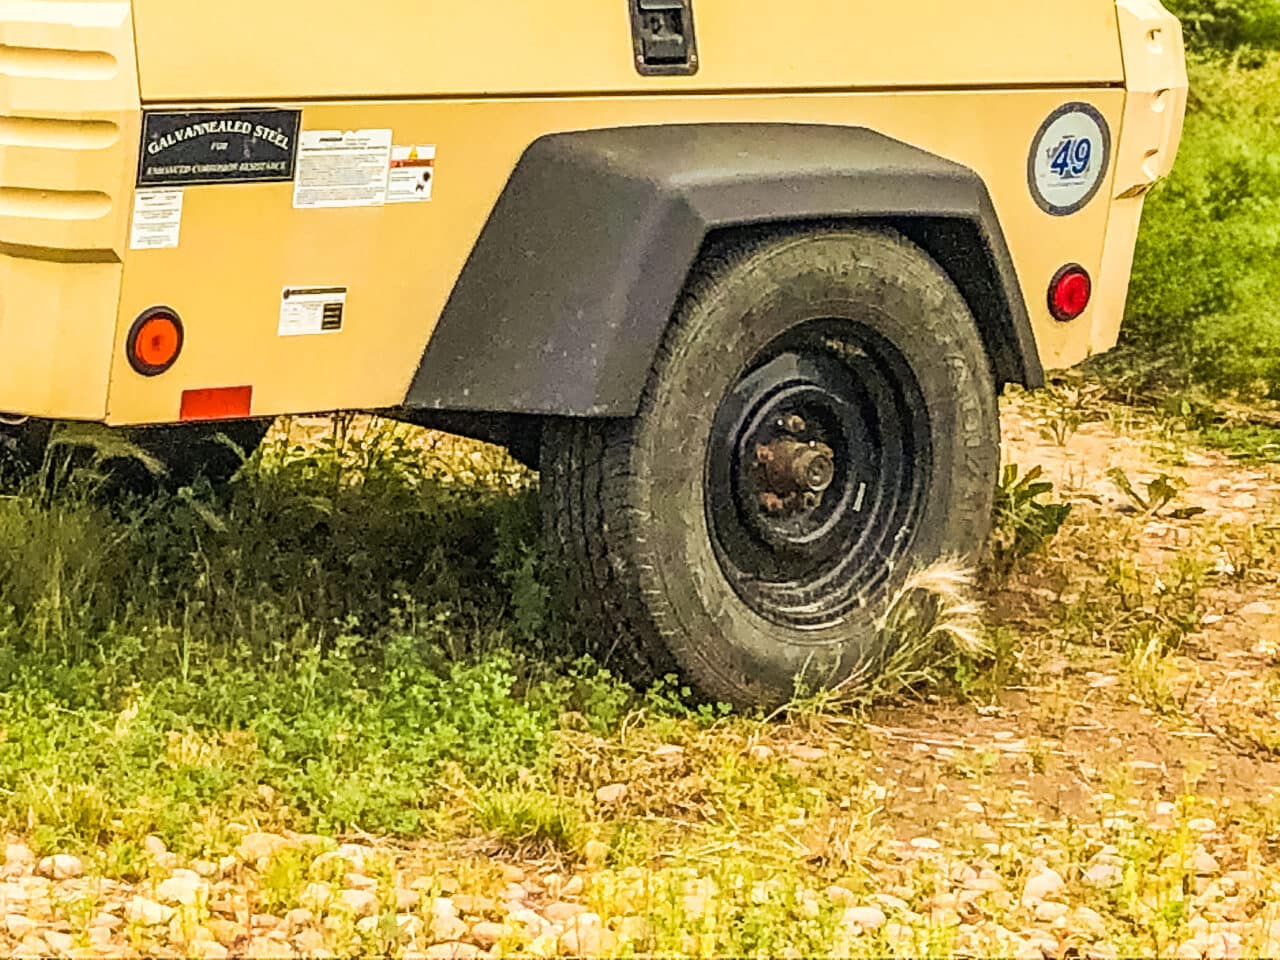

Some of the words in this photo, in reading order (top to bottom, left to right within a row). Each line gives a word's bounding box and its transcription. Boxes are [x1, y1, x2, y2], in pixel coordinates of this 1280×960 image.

[147, 121, 252, 154] GALVANNEALED
[254, 125, 289, 150] STEEL
[1050, 138, 1091, 176] 49
